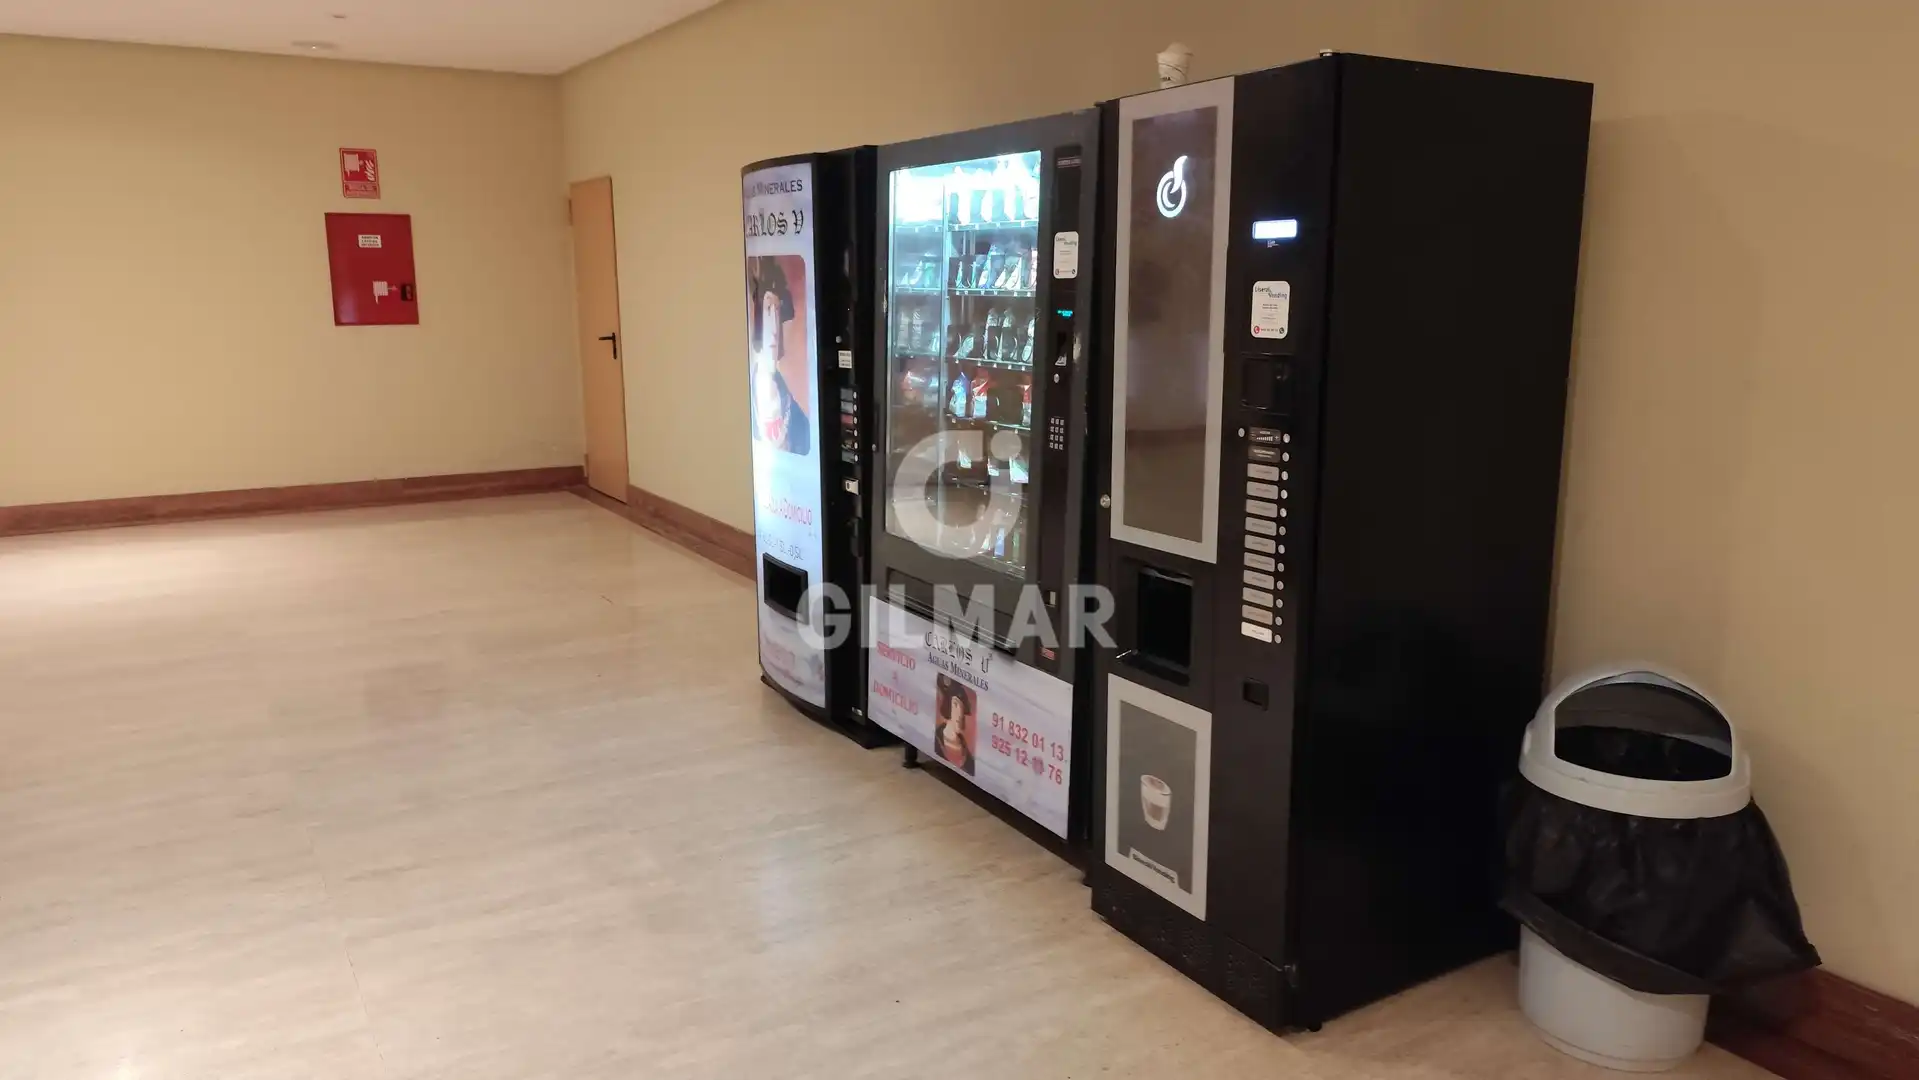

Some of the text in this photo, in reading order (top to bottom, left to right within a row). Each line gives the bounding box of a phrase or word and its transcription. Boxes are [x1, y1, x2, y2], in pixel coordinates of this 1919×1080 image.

[757, 179, 803, 196] MNERALES
[992, 712, 1064, 762] 91 832 01 13
[1048, 764, 1062, 786] 76
